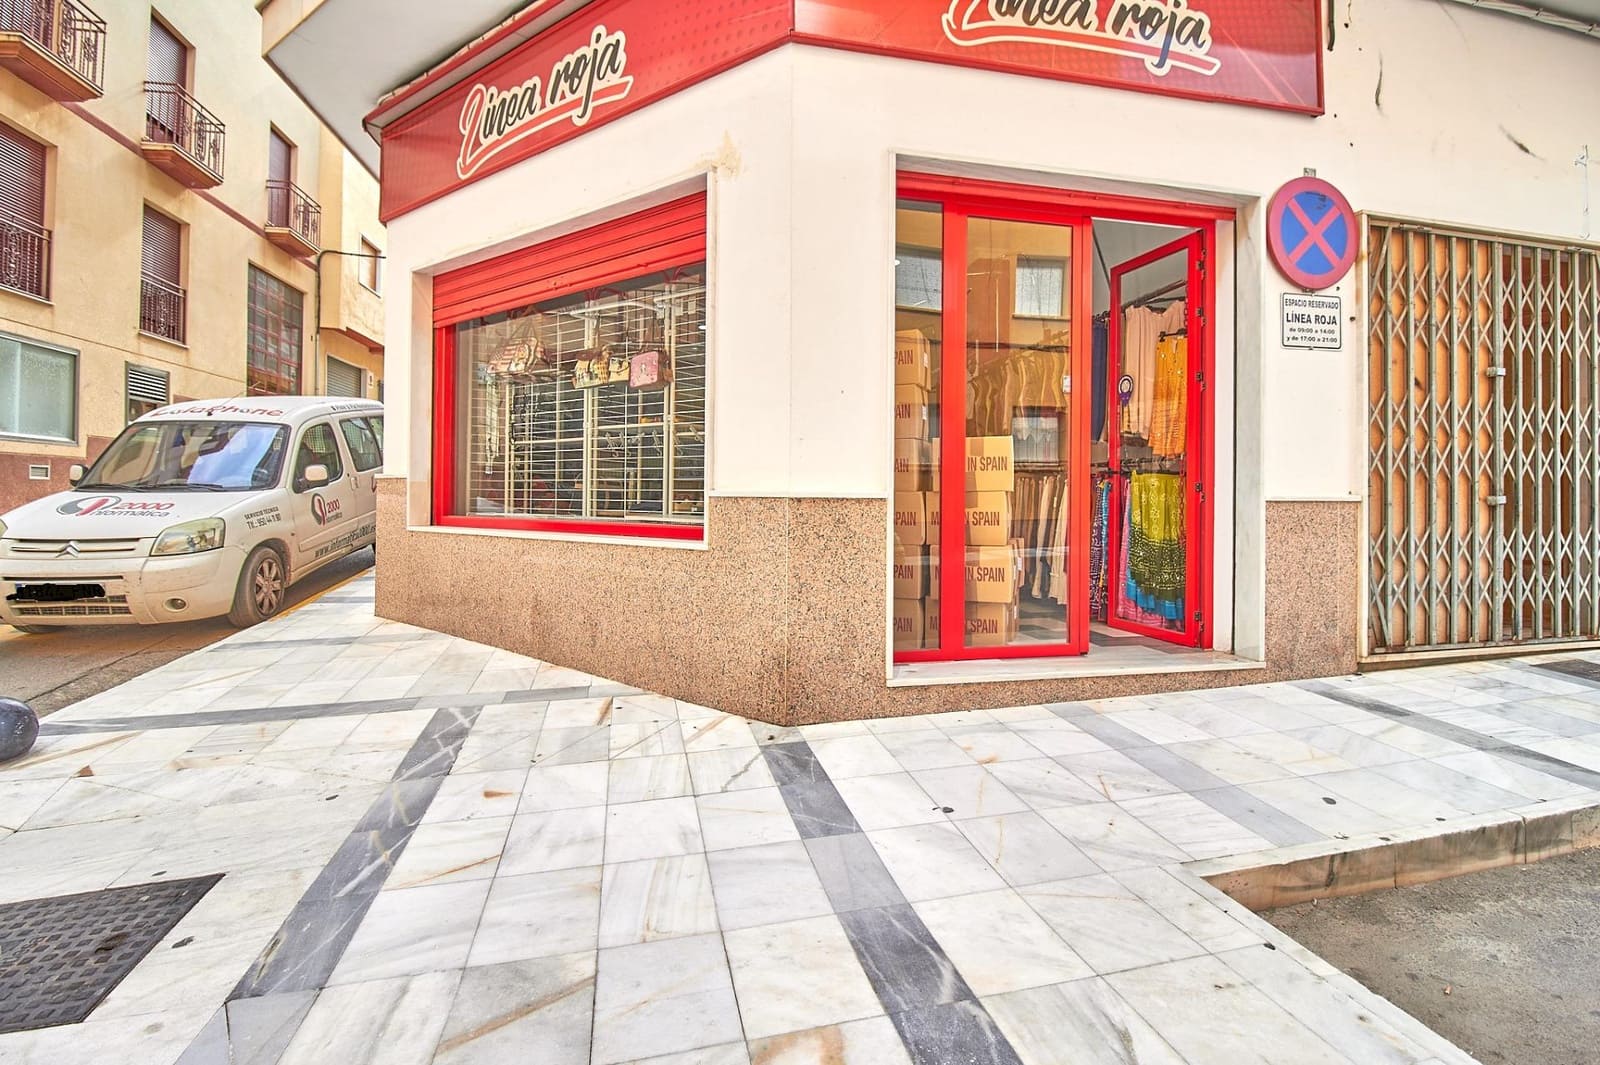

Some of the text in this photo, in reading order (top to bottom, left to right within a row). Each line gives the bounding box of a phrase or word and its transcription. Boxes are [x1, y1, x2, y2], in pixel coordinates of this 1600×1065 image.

[1111, 0, 1206, 69] roja
[458, 32, 622, 178] Linea roja
[1285, 298, 1339, 310] ESPACIO RESERVADO
[1314, 314, 1338, 326] ROJA
[967, 456, 1008, 472] IN SPAIN
[111, 502, 175, 511] 2000
[326, 499, 340, 514] 2000
[971, 511, 1000, 526] SPAIN
[976, 567, 1005, 582] SPAIN
[970, 619, 998, 633] SPAIN
